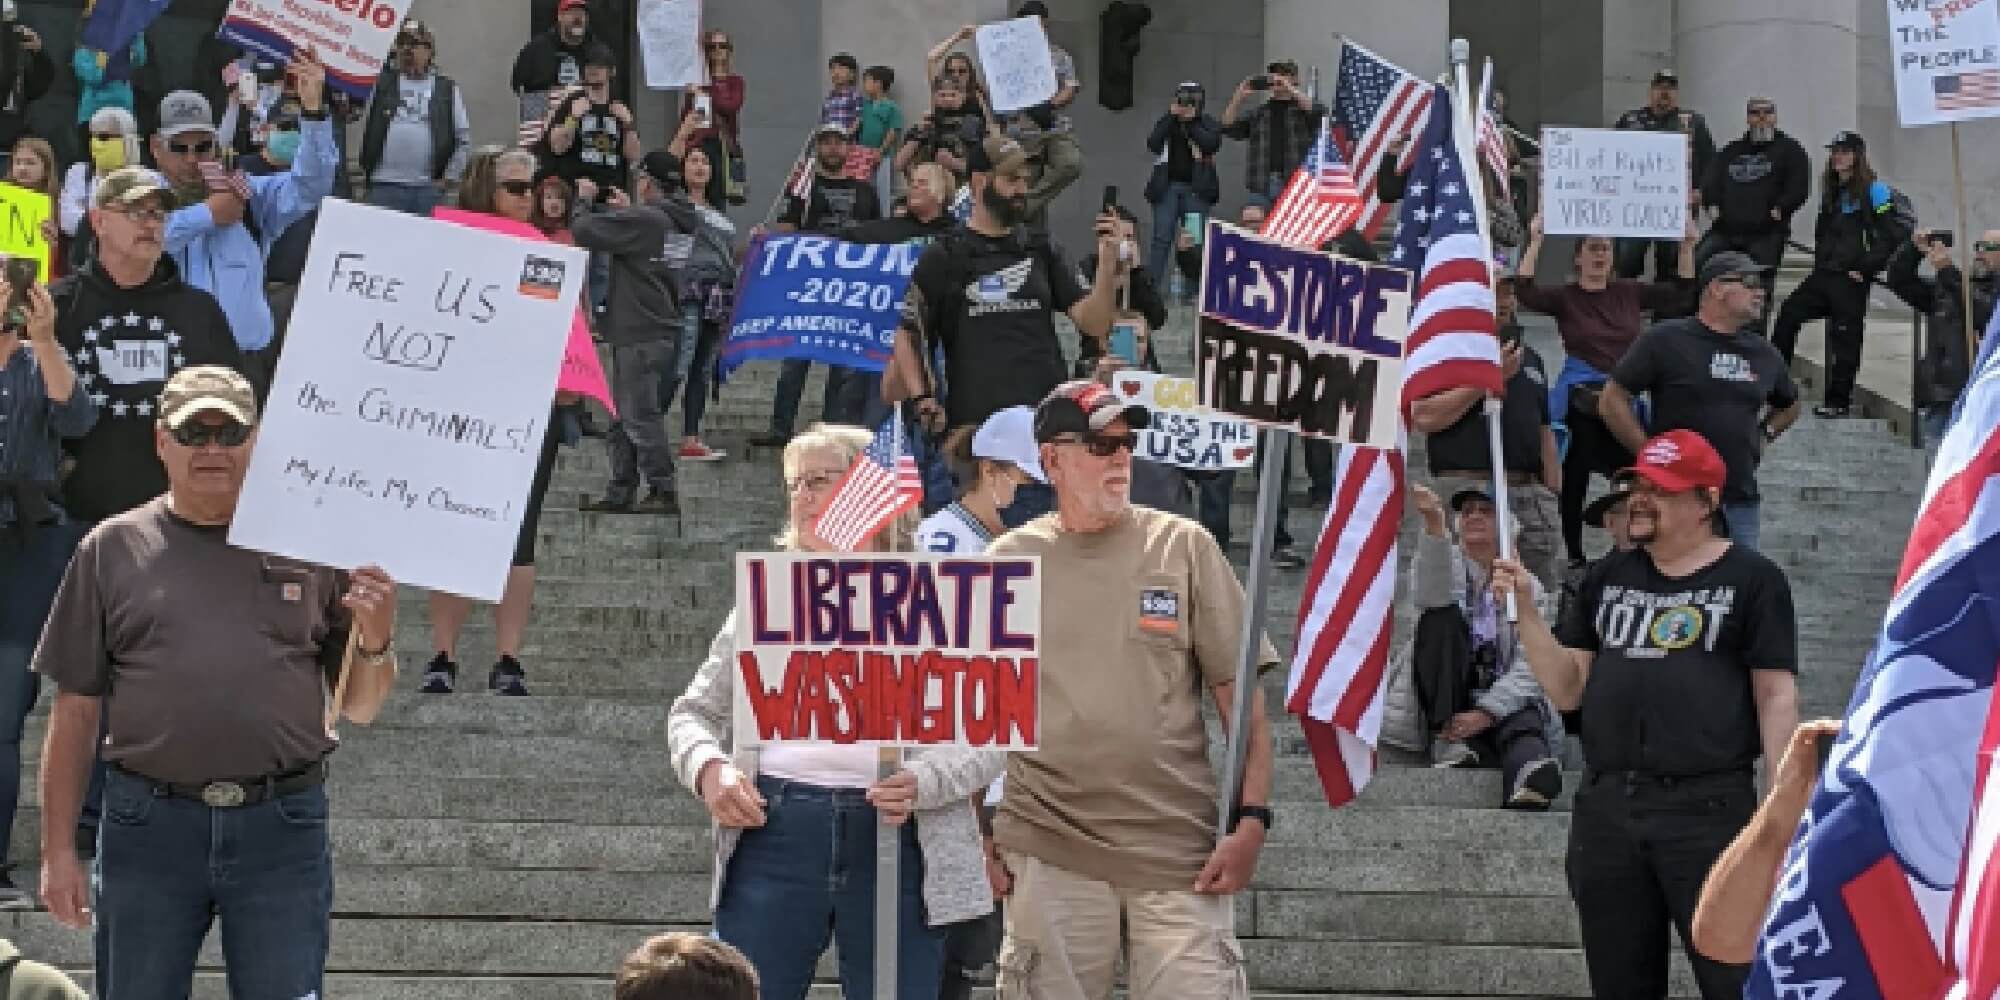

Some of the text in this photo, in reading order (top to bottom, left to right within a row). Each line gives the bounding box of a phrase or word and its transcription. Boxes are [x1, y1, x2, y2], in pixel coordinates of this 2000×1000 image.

[1896, 25, 1950, 45] THE
[1900, 45, 1998, 71] PEOPLE
[1548, 147, 1677, 177] Bill of Rights
[1557, 198, 1682, 231] VIRUS CLAUSE
[760, 236, 920, 277] TRUM
[434, 270, 500, 323] US
[1204, 222, 1414, 358] RESTORE
[363, 319, 456, 366] NOT
[776, 315, 875, 342] AMERICA
[297, 379, 342, 414] the
[1153, 378, 1196, 409] GO
[1199, 315, 1379, 445] FREEDOM
[1152, 411, 1253, 442] ESS THE
[1146, 431, 1223, 464] USA
[284, 456, 320, 487] My
[382, 477, 418, 509] My
[746, 558, 1035, 651] LIBERATE
[1711, 585, 1737, 606] AN
[736, 648, 1039, 747] WASHINGTON
